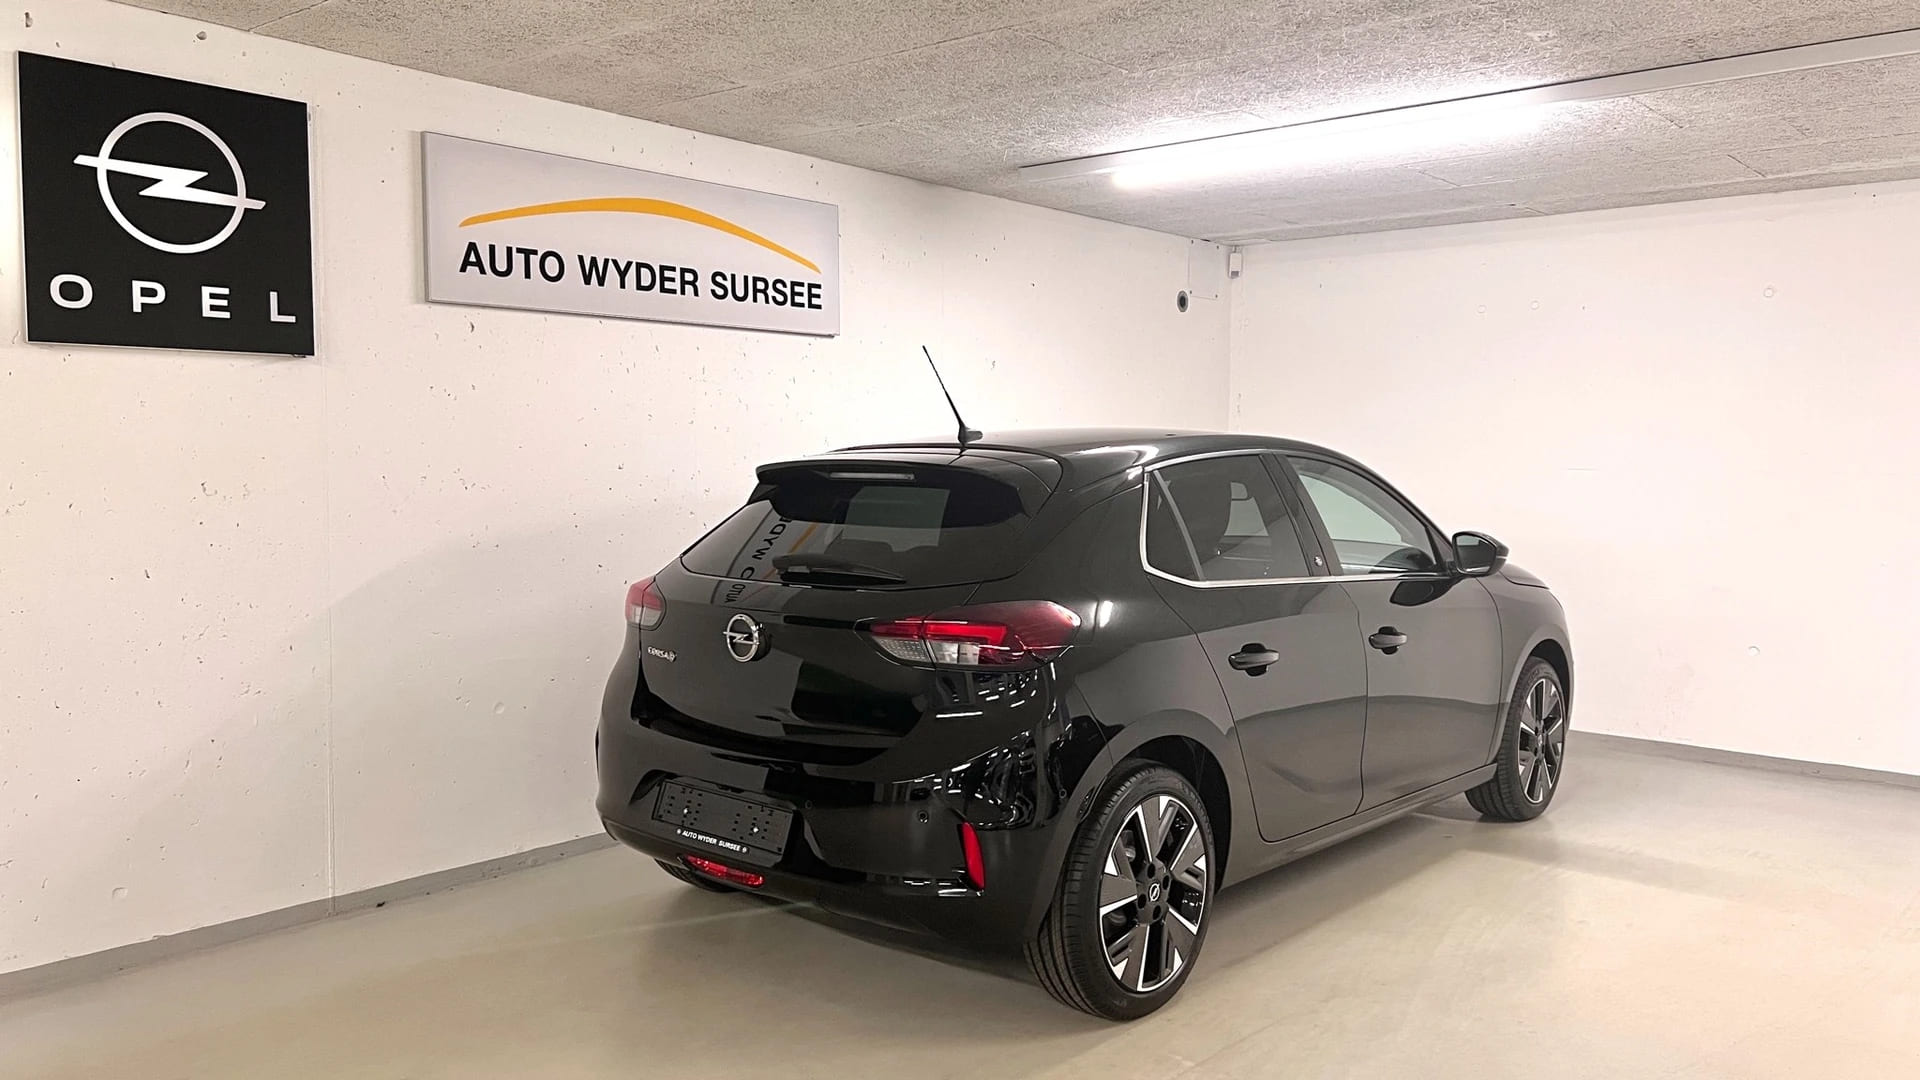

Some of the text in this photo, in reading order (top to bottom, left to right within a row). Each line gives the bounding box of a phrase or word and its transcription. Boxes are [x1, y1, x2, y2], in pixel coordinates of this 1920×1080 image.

[50, 273, 296, 323] OPEL
[459, 241, 823, 310] AUTO WYDER SURSEE
[682, 830, 741, 851] AUTO WYDER SURSEE
